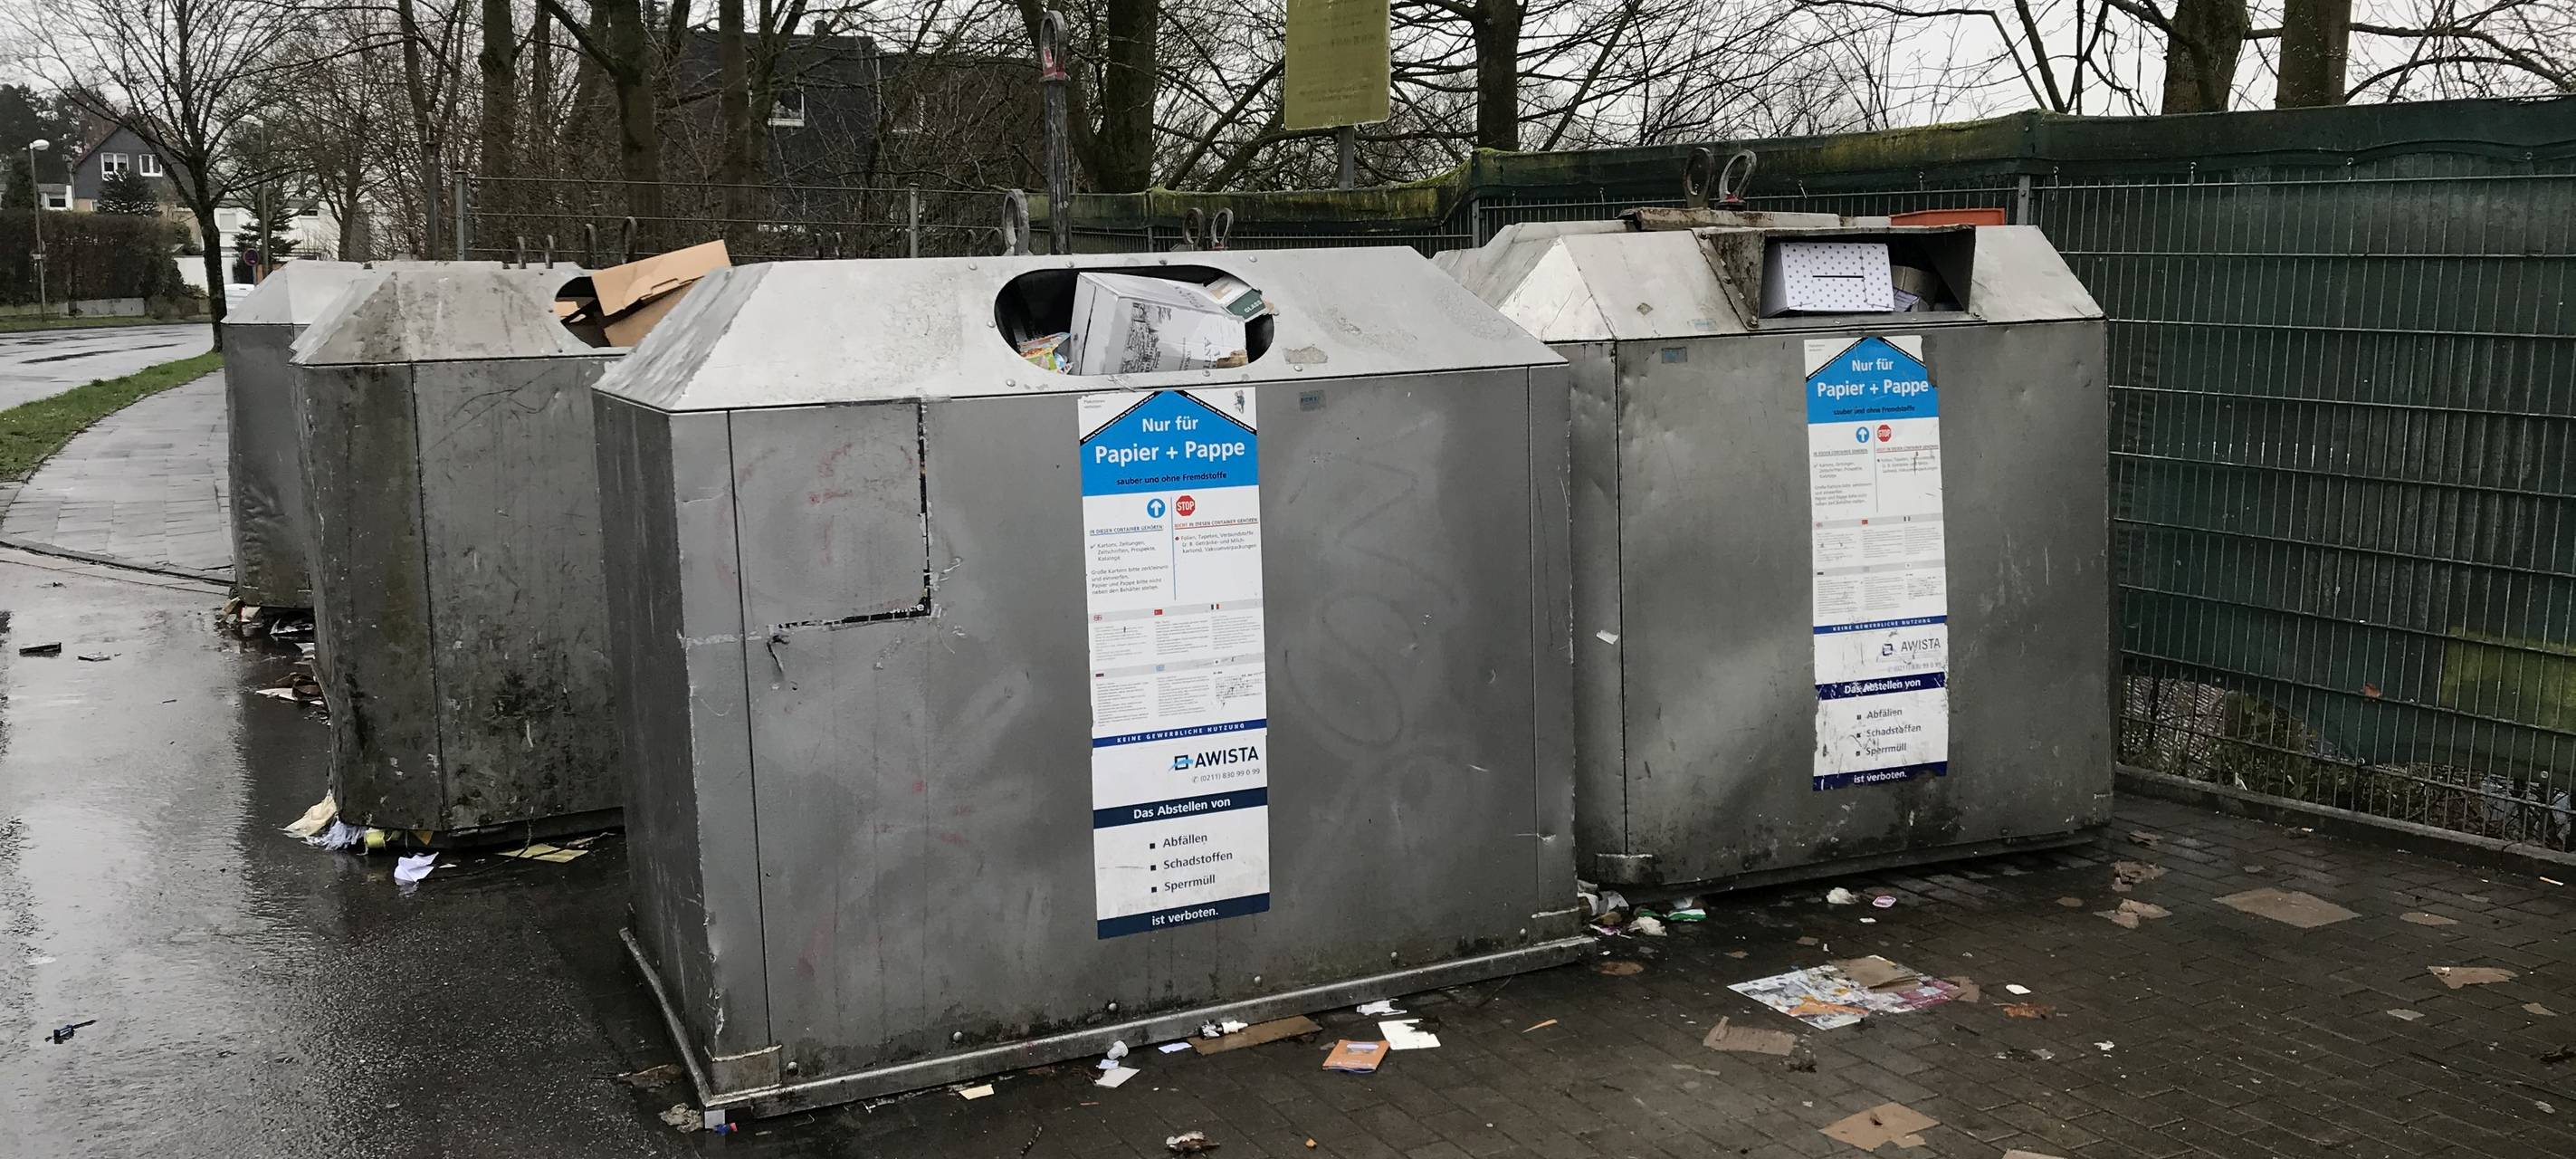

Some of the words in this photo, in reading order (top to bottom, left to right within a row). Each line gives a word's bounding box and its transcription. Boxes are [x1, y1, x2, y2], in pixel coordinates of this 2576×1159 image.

[1852, 359, 1874, 371] Nur
[1876, 358, 1894, 370] für
[1817, 380, 1865, 400] Papier
[1869, 383, 1879, 395] +
[1884, 378, 1929, 397] Pappe
[1142, 417, 1170, 433] Nur
[1177, 416, 1198, 431] für
[1095, 444, 1159, 466] Papier
[1166, 446, 1178, 459] +
[1185, 441, 1245, 463] Pappe
[1116, 476, 1142, 485] sauber
[1144, 474, 1159, 484] und
[1161, 473, 1180, 483] ohne
[1182, 471, 1226, 482] Fremdstoffe
[1177, 501, 1194, 512] STOP
[1901, 637, 1942, 653] AWISTA
[1863, 680, 1903, 694] Abstellen
[1904, 678, 1921, 689] von
[1866, 708, 1903, 719] Abfällen
[1117, 735, 1141, 744] KEINE
[1146, 727, 1203, 739] GEWERBLICHE
[1207, 723, 1245, 733] NUTZUNG
[1866, 723, 1922, 738] Schadstoffen
[1194, 745, 1259, 769] AWISTA
[1865, 742, 1907, 756] Sperrmüll
[1222, 771, 1236, 779] 830
[1854, 774, 1865, 783] ist
[1866, 770, 1907, 782] verboten.
[1133, 809, 1154, 819] Das
[1157, 800, 1208, 817] Abstellen
[1211, 798, 1231, 809] von
[1162, 833, 1207, 848] Abfällen
[1163, 851, 1233, 869] Schadstoffen
[1164, 874, 1216, 893] Sperrmüll
[1151, 915, 1166, 925] ist
[1168, 907, 1219, 924] verboten.
